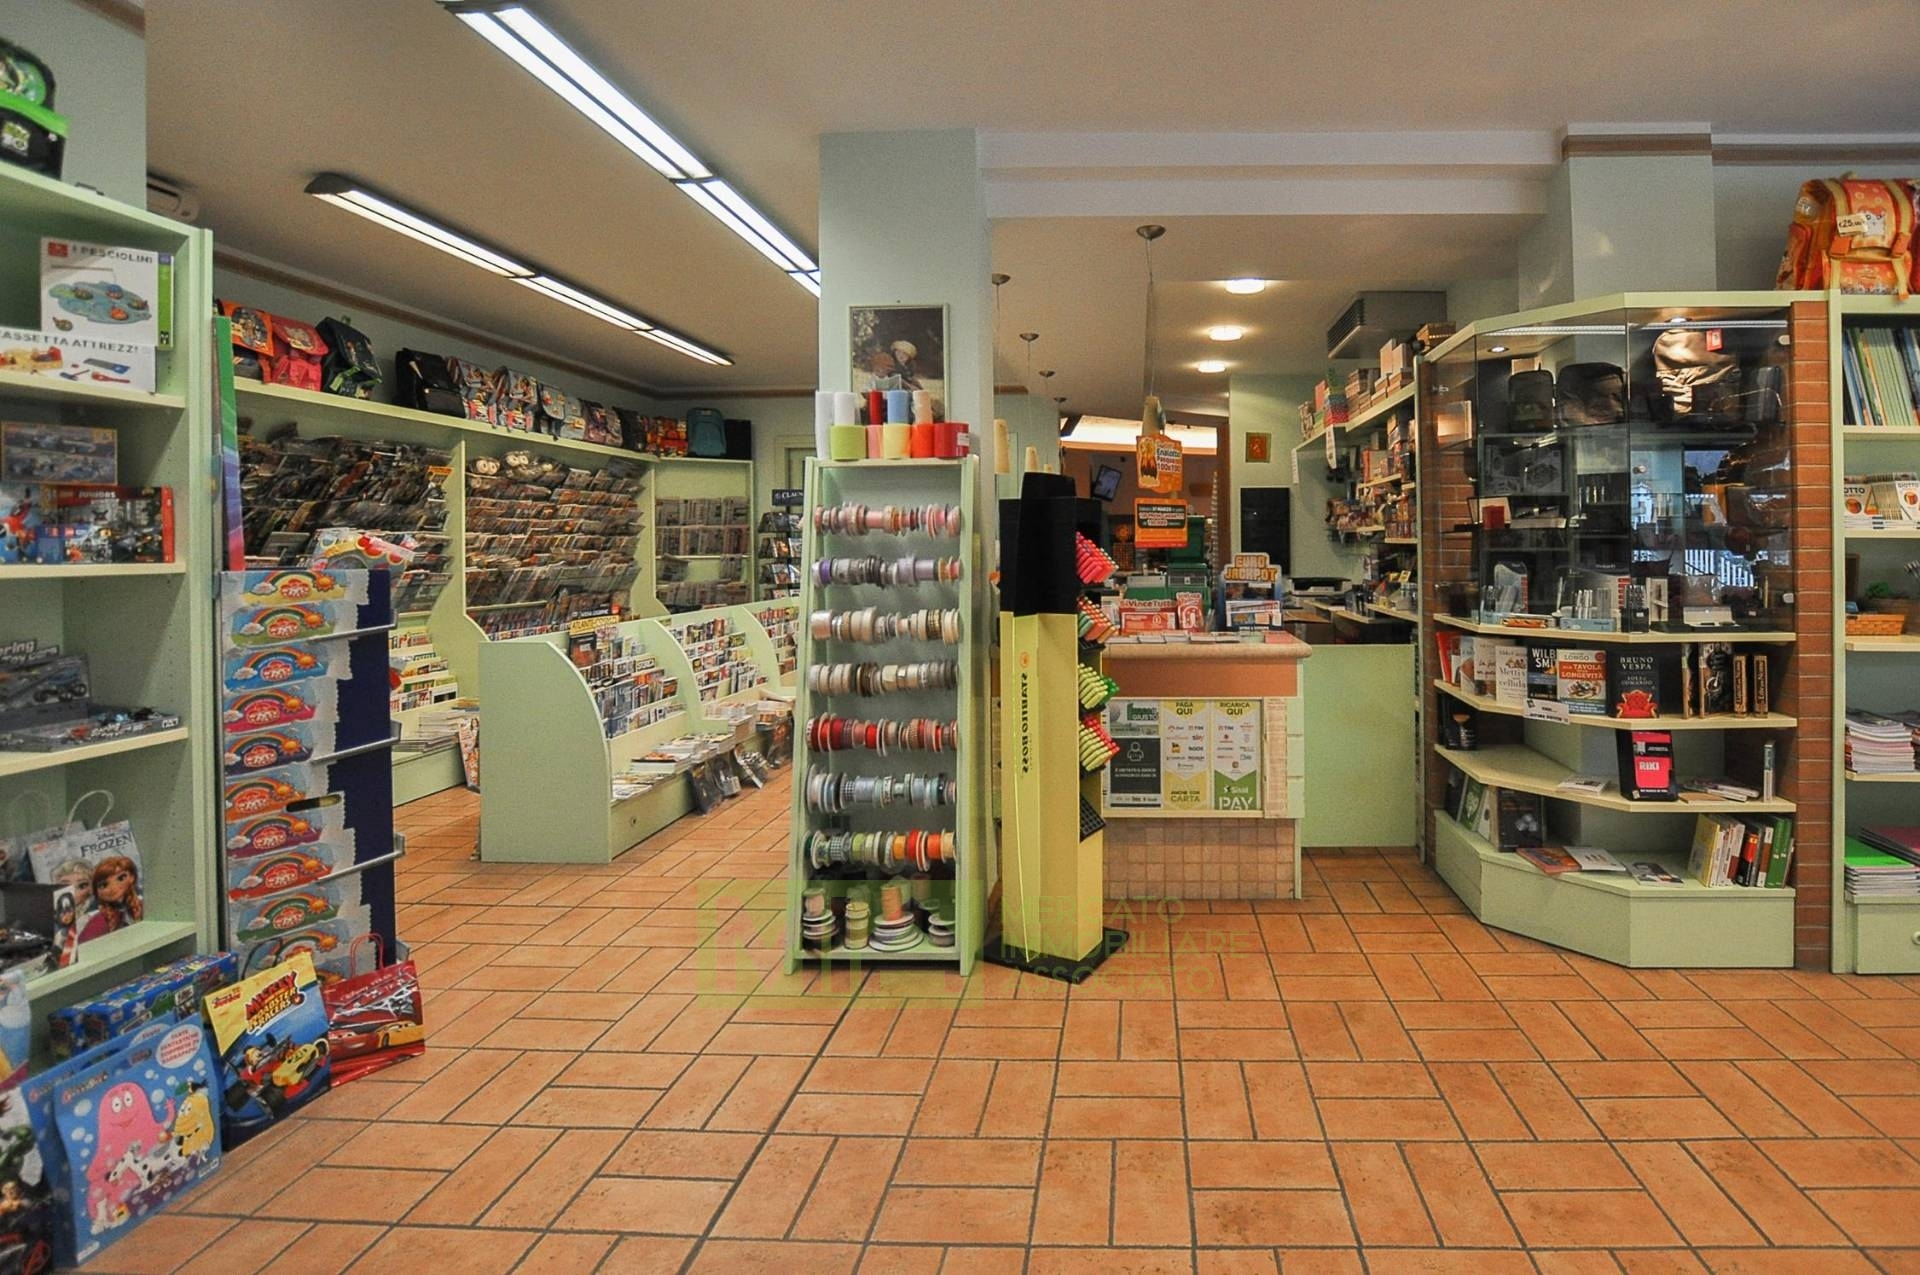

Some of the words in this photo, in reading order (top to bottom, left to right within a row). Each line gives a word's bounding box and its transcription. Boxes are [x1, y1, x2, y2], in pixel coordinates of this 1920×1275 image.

[81, 246, 153, 263] PESCIOLINI
[0, 330, 68, 346] ASSETTA
[1224, 567, 1278, 582] JACKPOT
[1531, 648, 1556, 658] WILB
[1620, 656, 1654, 664] BRUNO
[1561, 671, 1604, 679] LONGEVITÀ
[1500, 680, 1527, 689] cellula
[1021, 672, 1029, 733] STABILO
[1639, 761, 1661, 771] RIKI
[1171, 795, 1200, 803] CARTA
[1219, 796, 1254, 810] PAY
[80, 832, 133, 858] FROZEN
[245, 970, 297, 1020] MICKEY
[247, 986, 297, 1031] ROADSTER
[259, 1000, 292, 1028] RACERS
